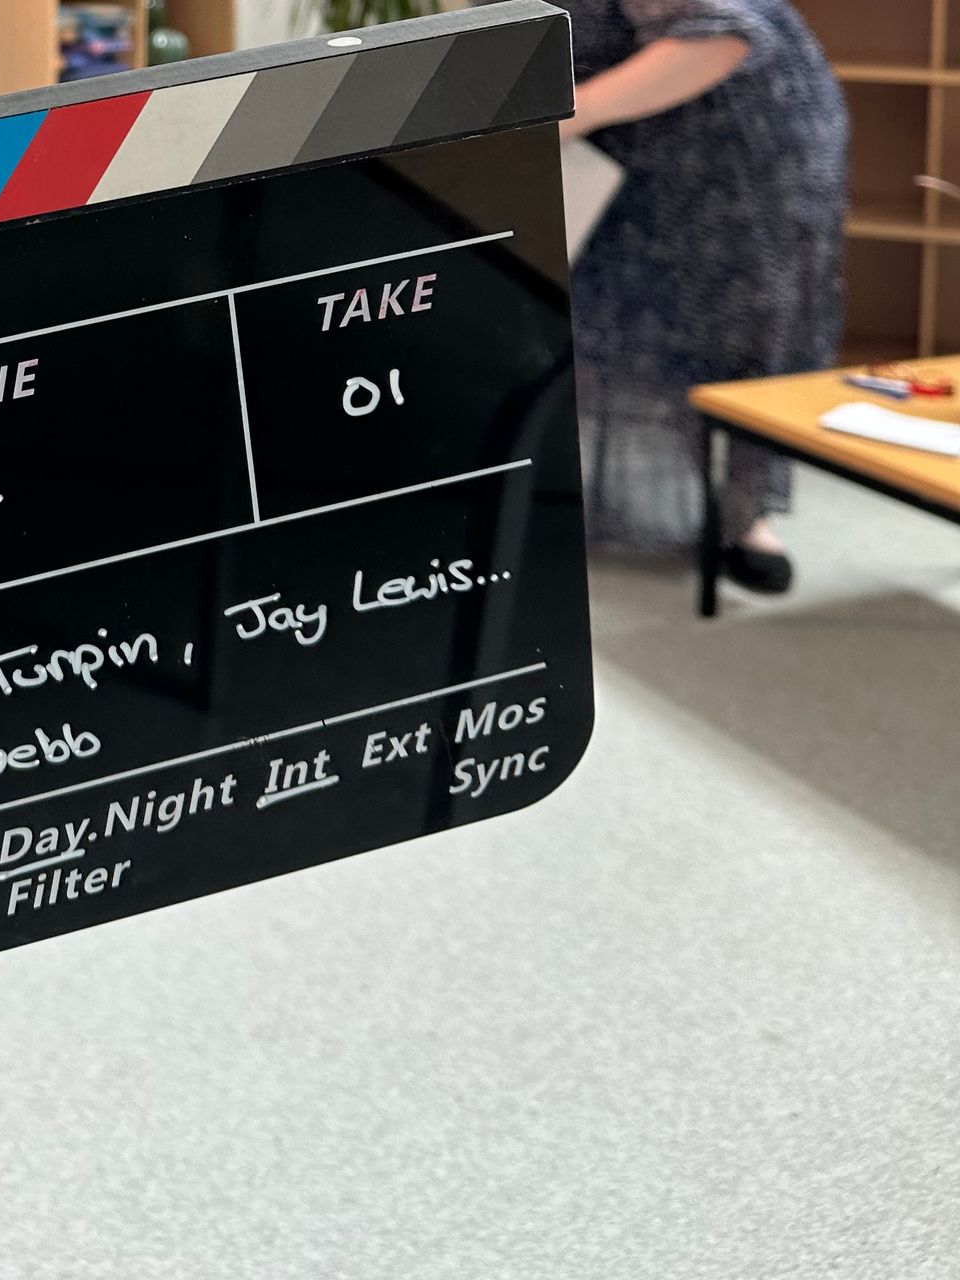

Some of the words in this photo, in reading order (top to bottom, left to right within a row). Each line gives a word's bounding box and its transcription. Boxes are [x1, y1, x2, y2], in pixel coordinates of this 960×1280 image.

[317, 274, 437, 331] TAKE
[342, 368, 405, 417] 01
[223, 592, 328, 646] Jay
[264, 749, 331, 796] Int
[361, 722, 432, 768] Ext
[455, 696, 547, 743] Mos
[449, 743, 550, 798] Sync
[7, 856, 132, 916] Filter
